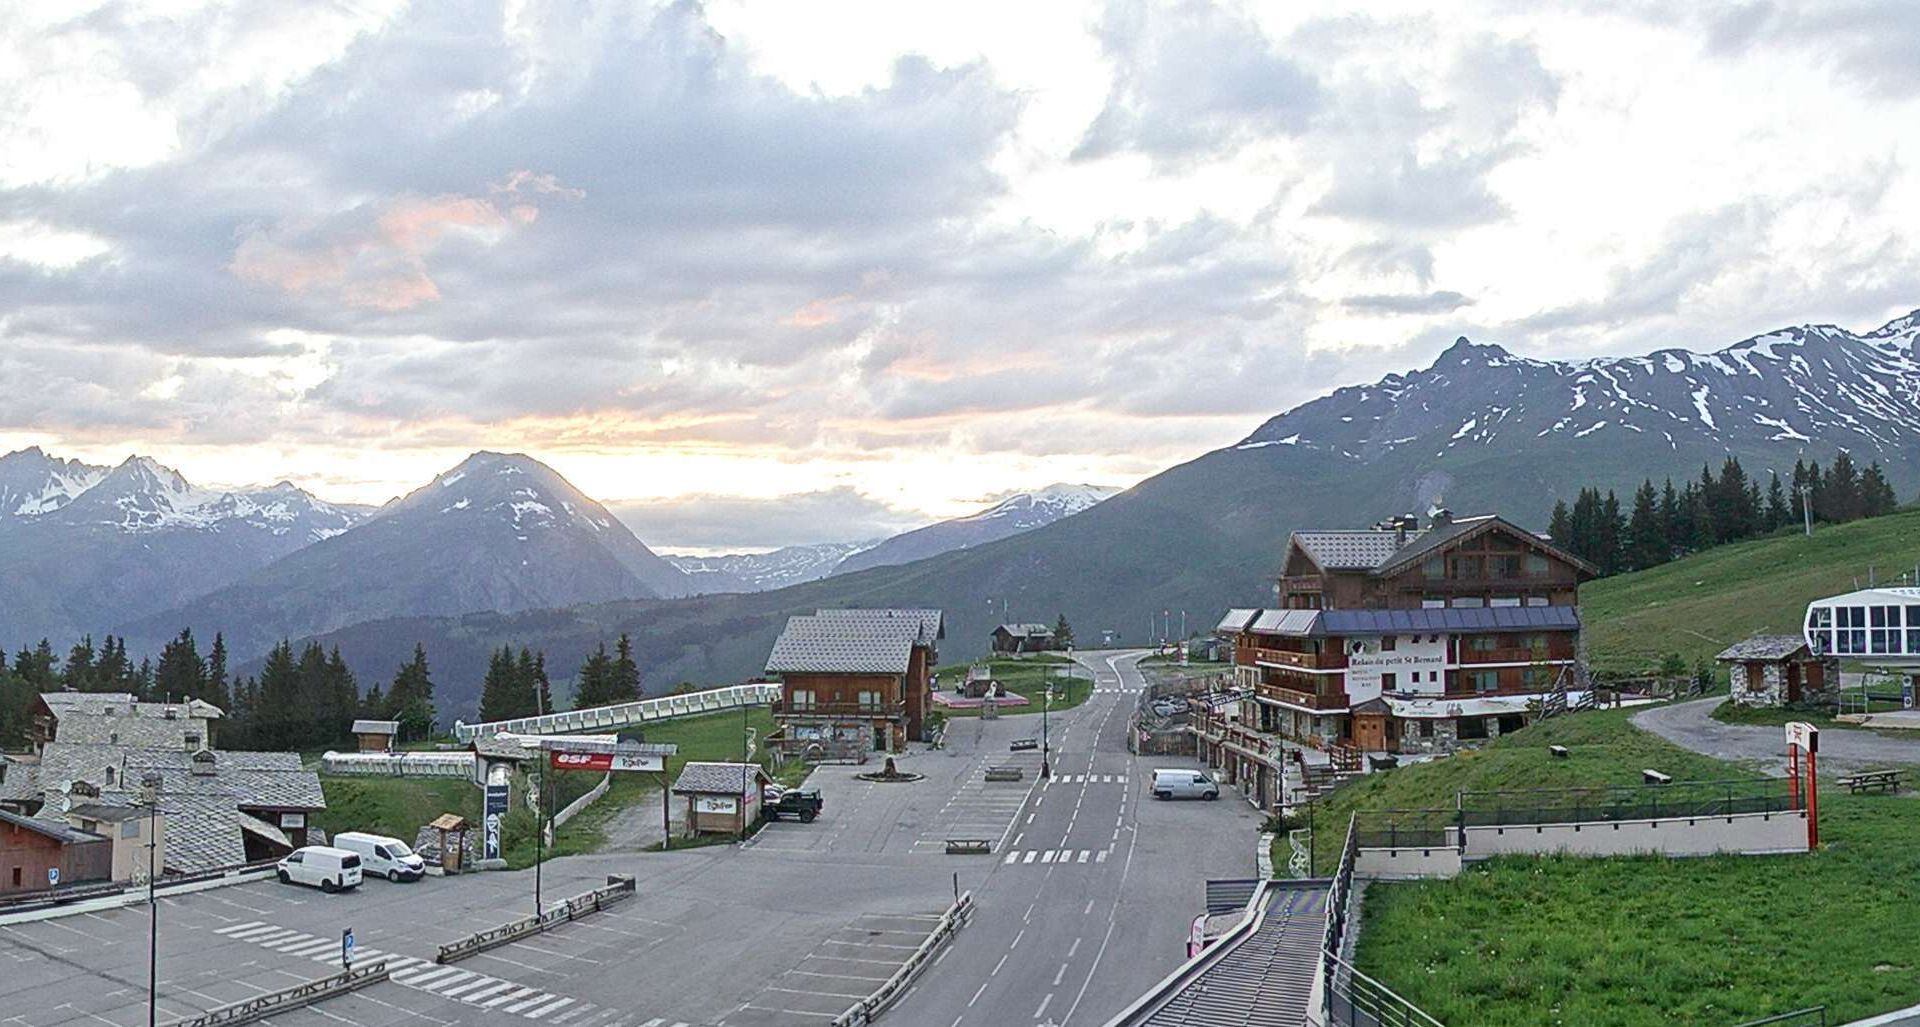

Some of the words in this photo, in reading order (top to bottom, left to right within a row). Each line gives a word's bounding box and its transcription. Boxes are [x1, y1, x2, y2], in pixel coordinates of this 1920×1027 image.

[1385, 656, 1402, 666] petit
[1404, 656, 1412, 664] St
[1413, 655, 1443, 664] Bernard
